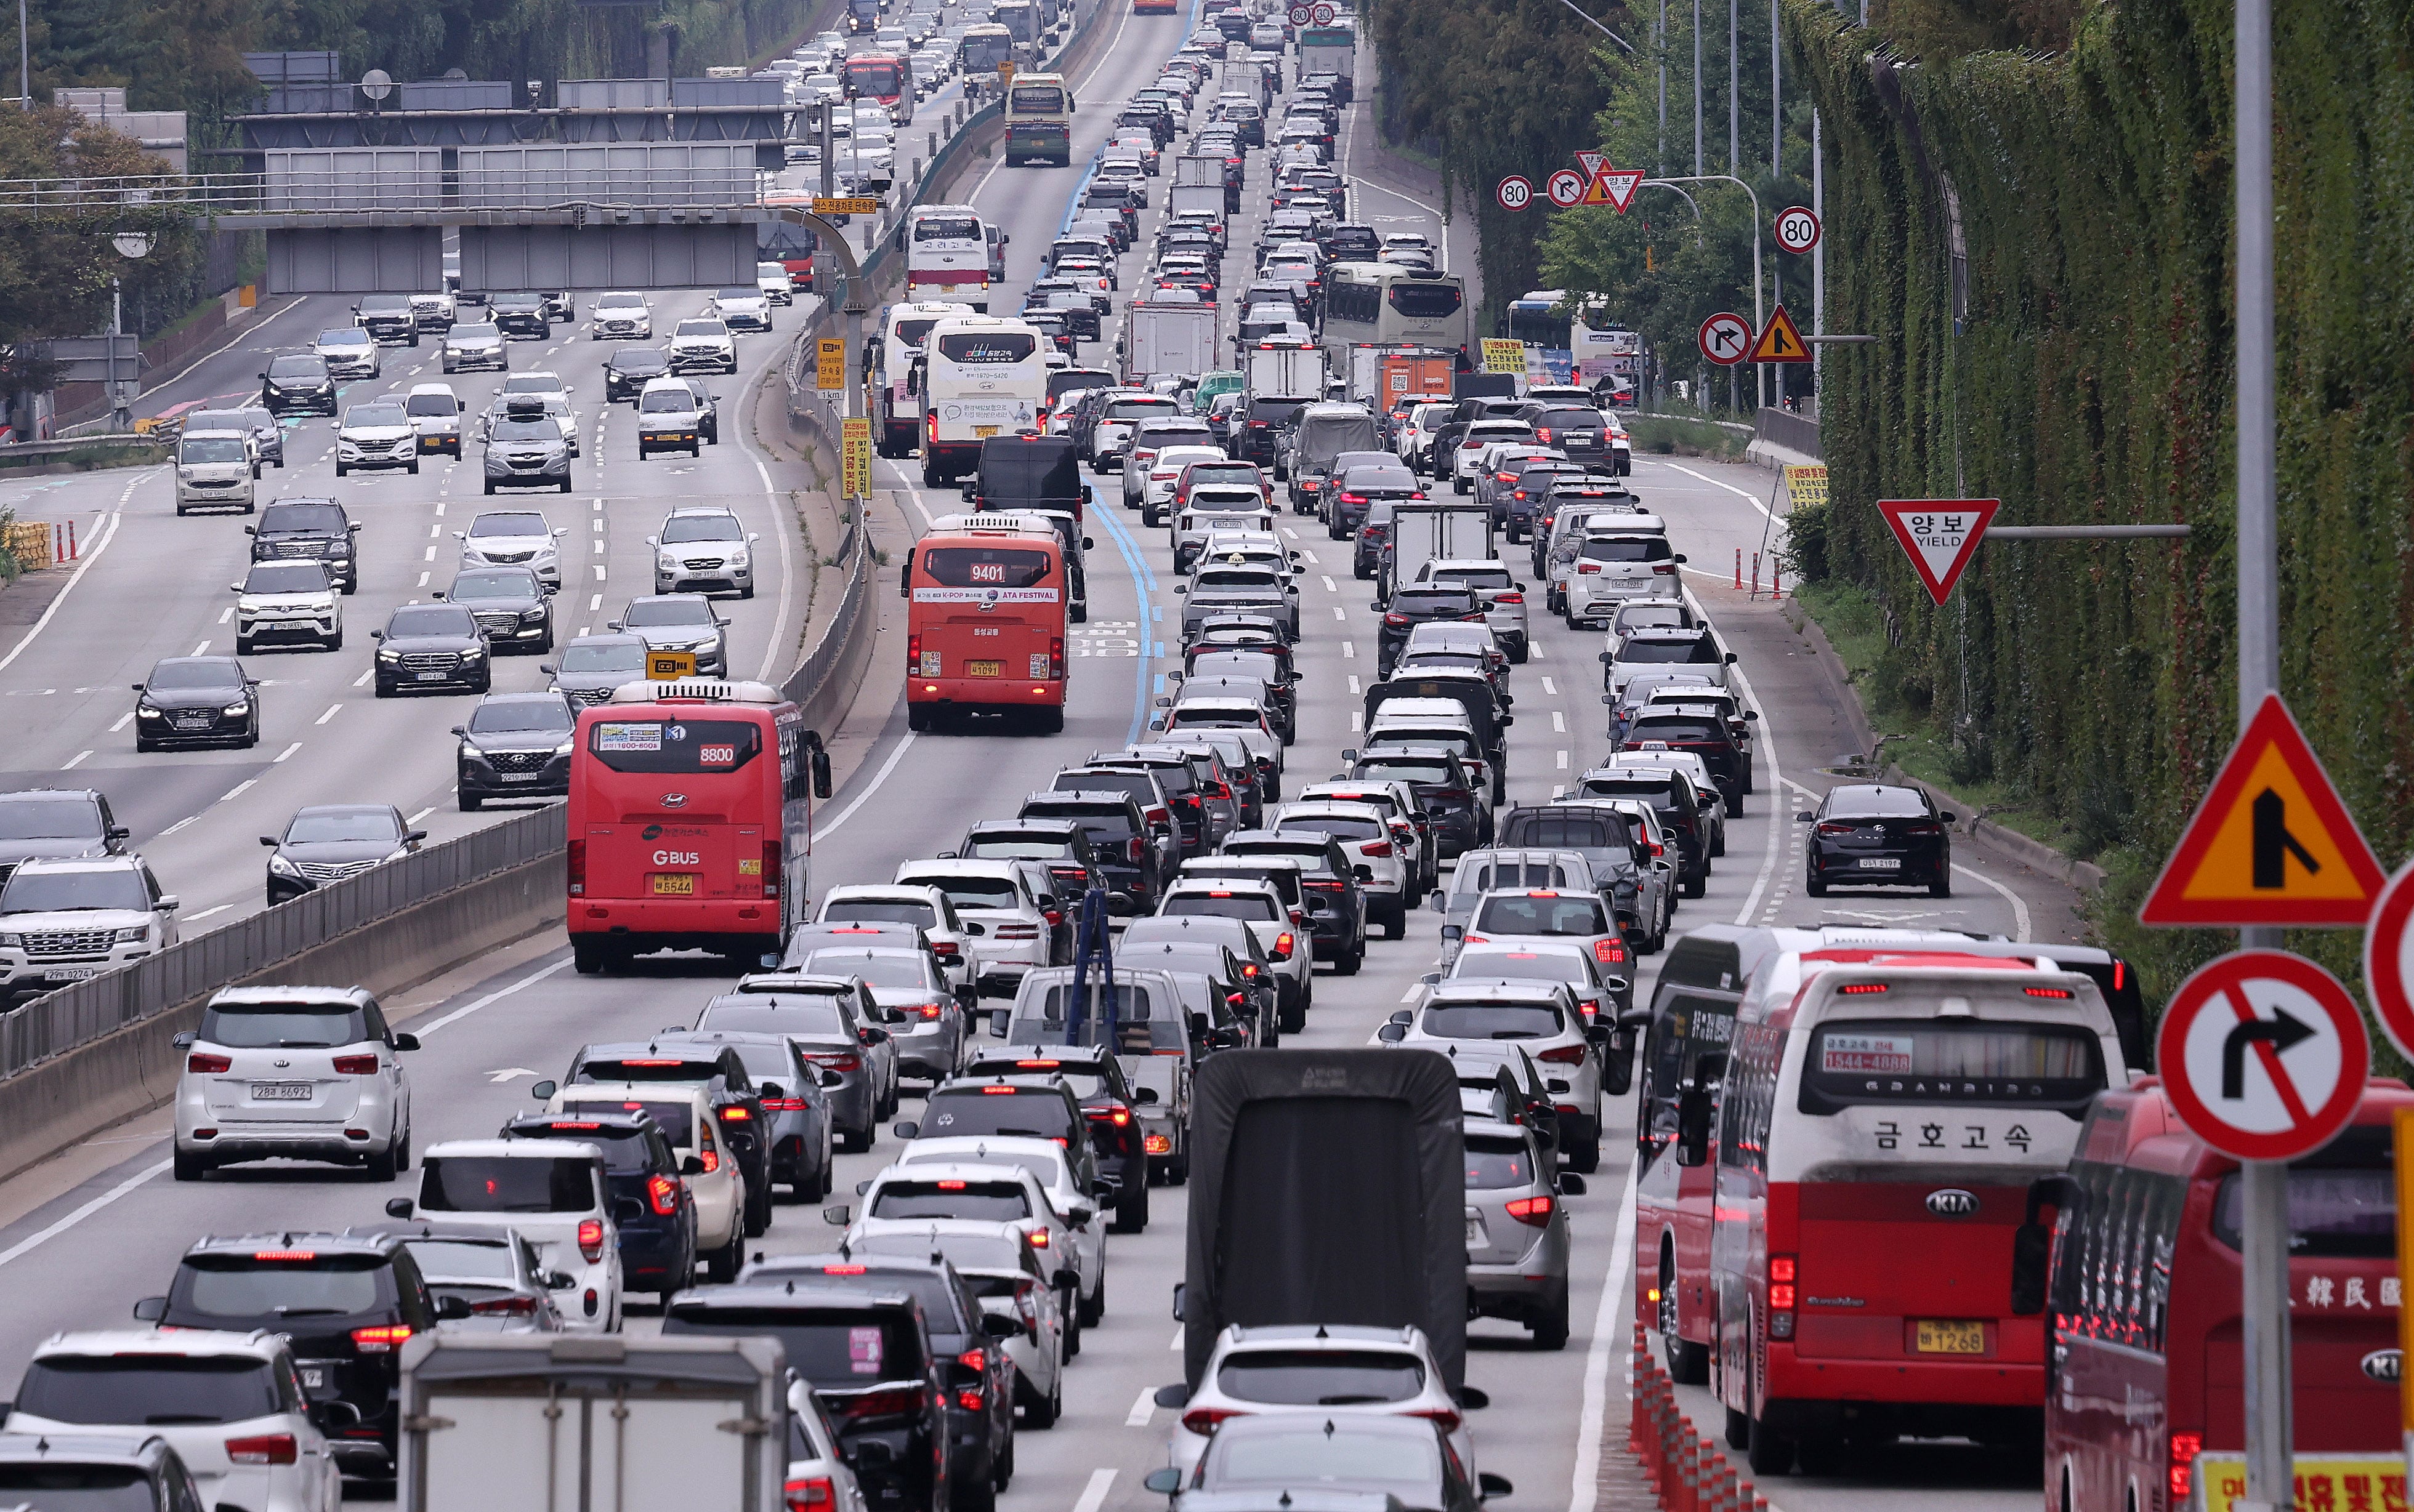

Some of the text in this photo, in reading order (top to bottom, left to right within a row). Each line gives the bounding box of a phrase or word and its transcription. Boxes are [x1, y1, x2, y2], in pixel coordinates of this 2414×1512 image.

[1293, 10, 1307, 20] 80
[1317, 8, 1330, 18] 30
[1608, 176, 1631, 185] 양보
[1504, 185, 1525, 202] 80
[814, 201, 874, 212] 버스 전용차로 단속중
[1785, 219, 1812, 242] 80
[1911, 515, 1965, 534] 양보
[1916, 536, 1961, 547] YIELD
[972, 565, 1004, 582] 9401
[979, 667, 996, 675] 1091
[700, 749, 733, 762] 8800
[68, 970, 89, 978] 0274
[1874, 1122, 2032, 1152] 금호고속
[1935, 1194, 1971, 1212] KIA
[2288, 1276, 2402, 1309] 韓民國
[1936, 1332, 1981, 1351] 1268
